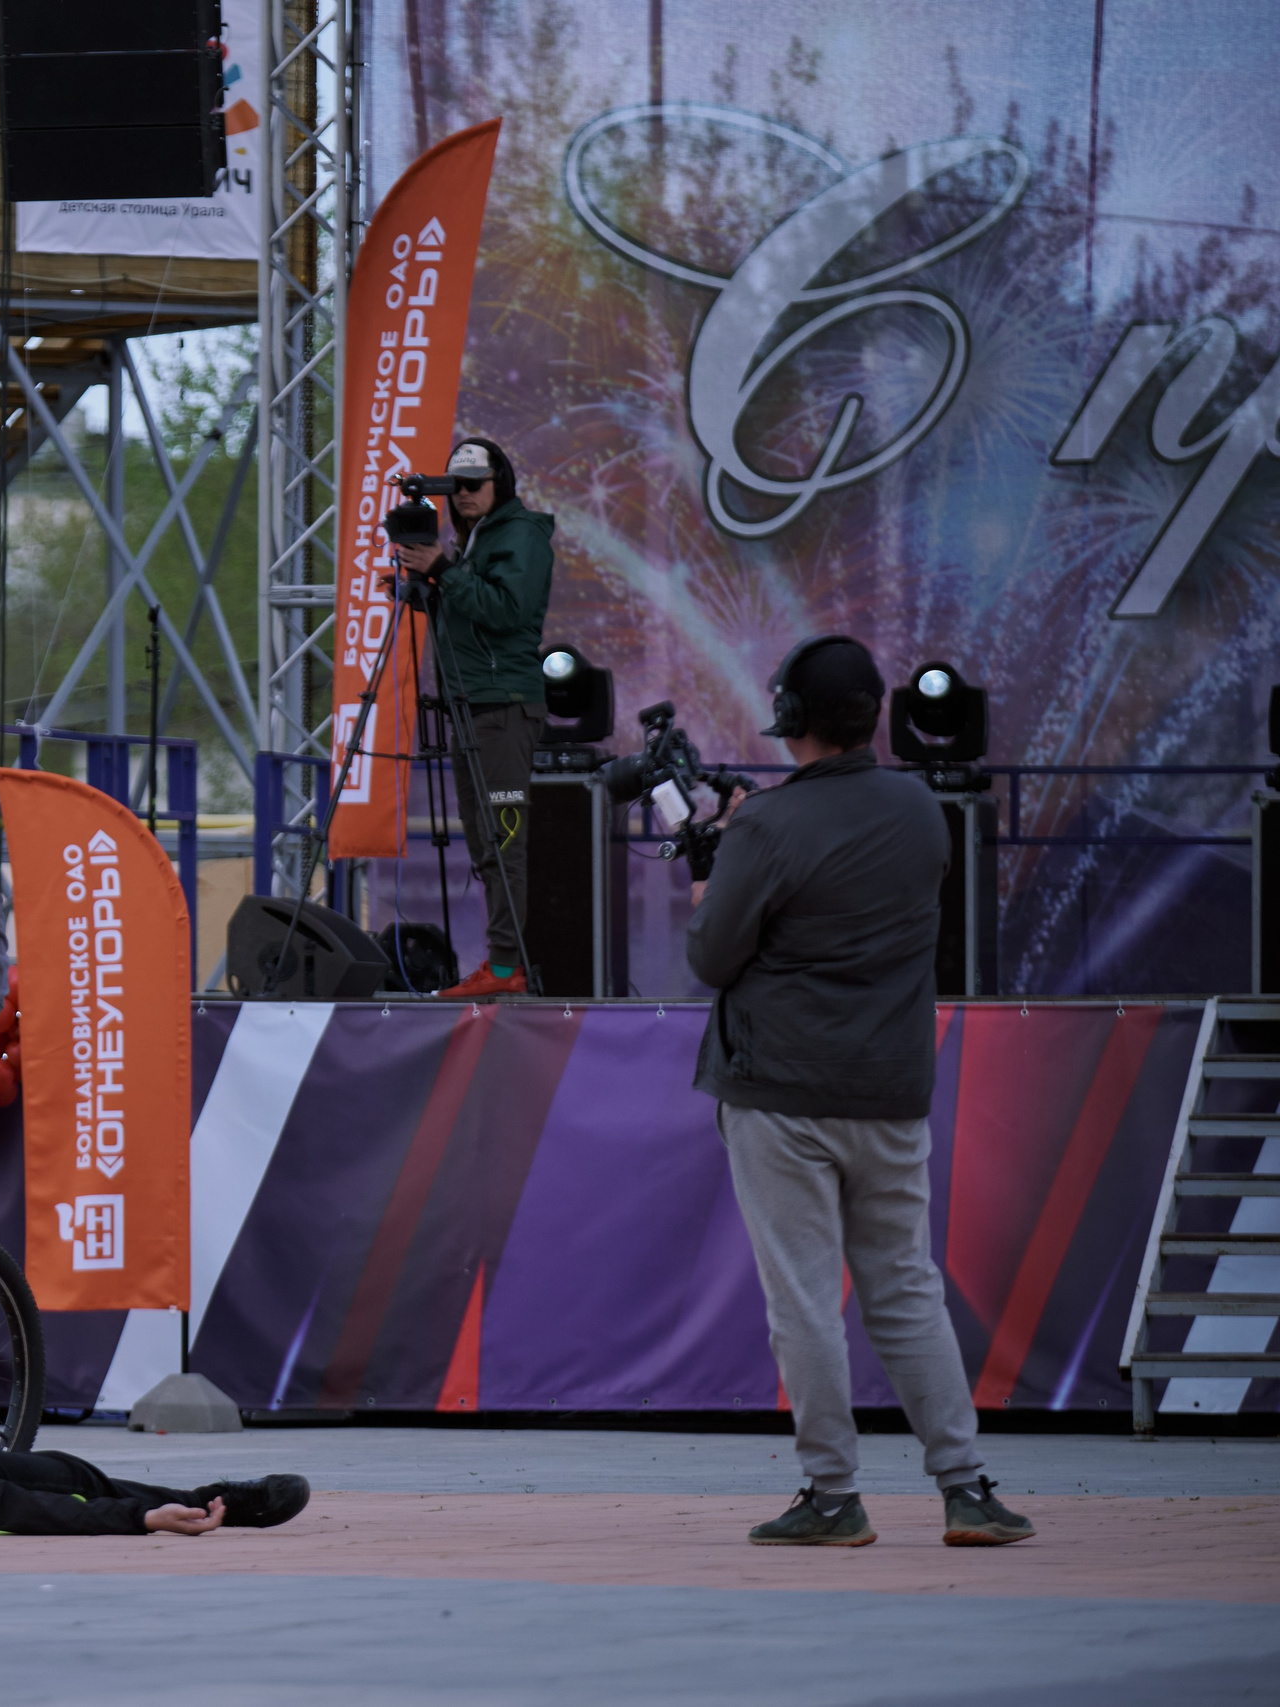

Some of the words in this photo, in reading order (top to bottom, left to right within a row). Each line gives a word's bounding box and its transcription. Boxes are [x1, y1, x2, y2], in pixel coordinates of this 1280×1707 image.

[120, 203, 177, 216] столица
[181, 203, 226, 218] Урала
[343, 331, 398, 667] БОГДАНОВИЧСКОЕ
[385, 233, 412, 309] ОАО
[63, 843, 87, 902] ОАО
[67, 916, 93, 1170] БОГДАНОВИЧСКОЕ
